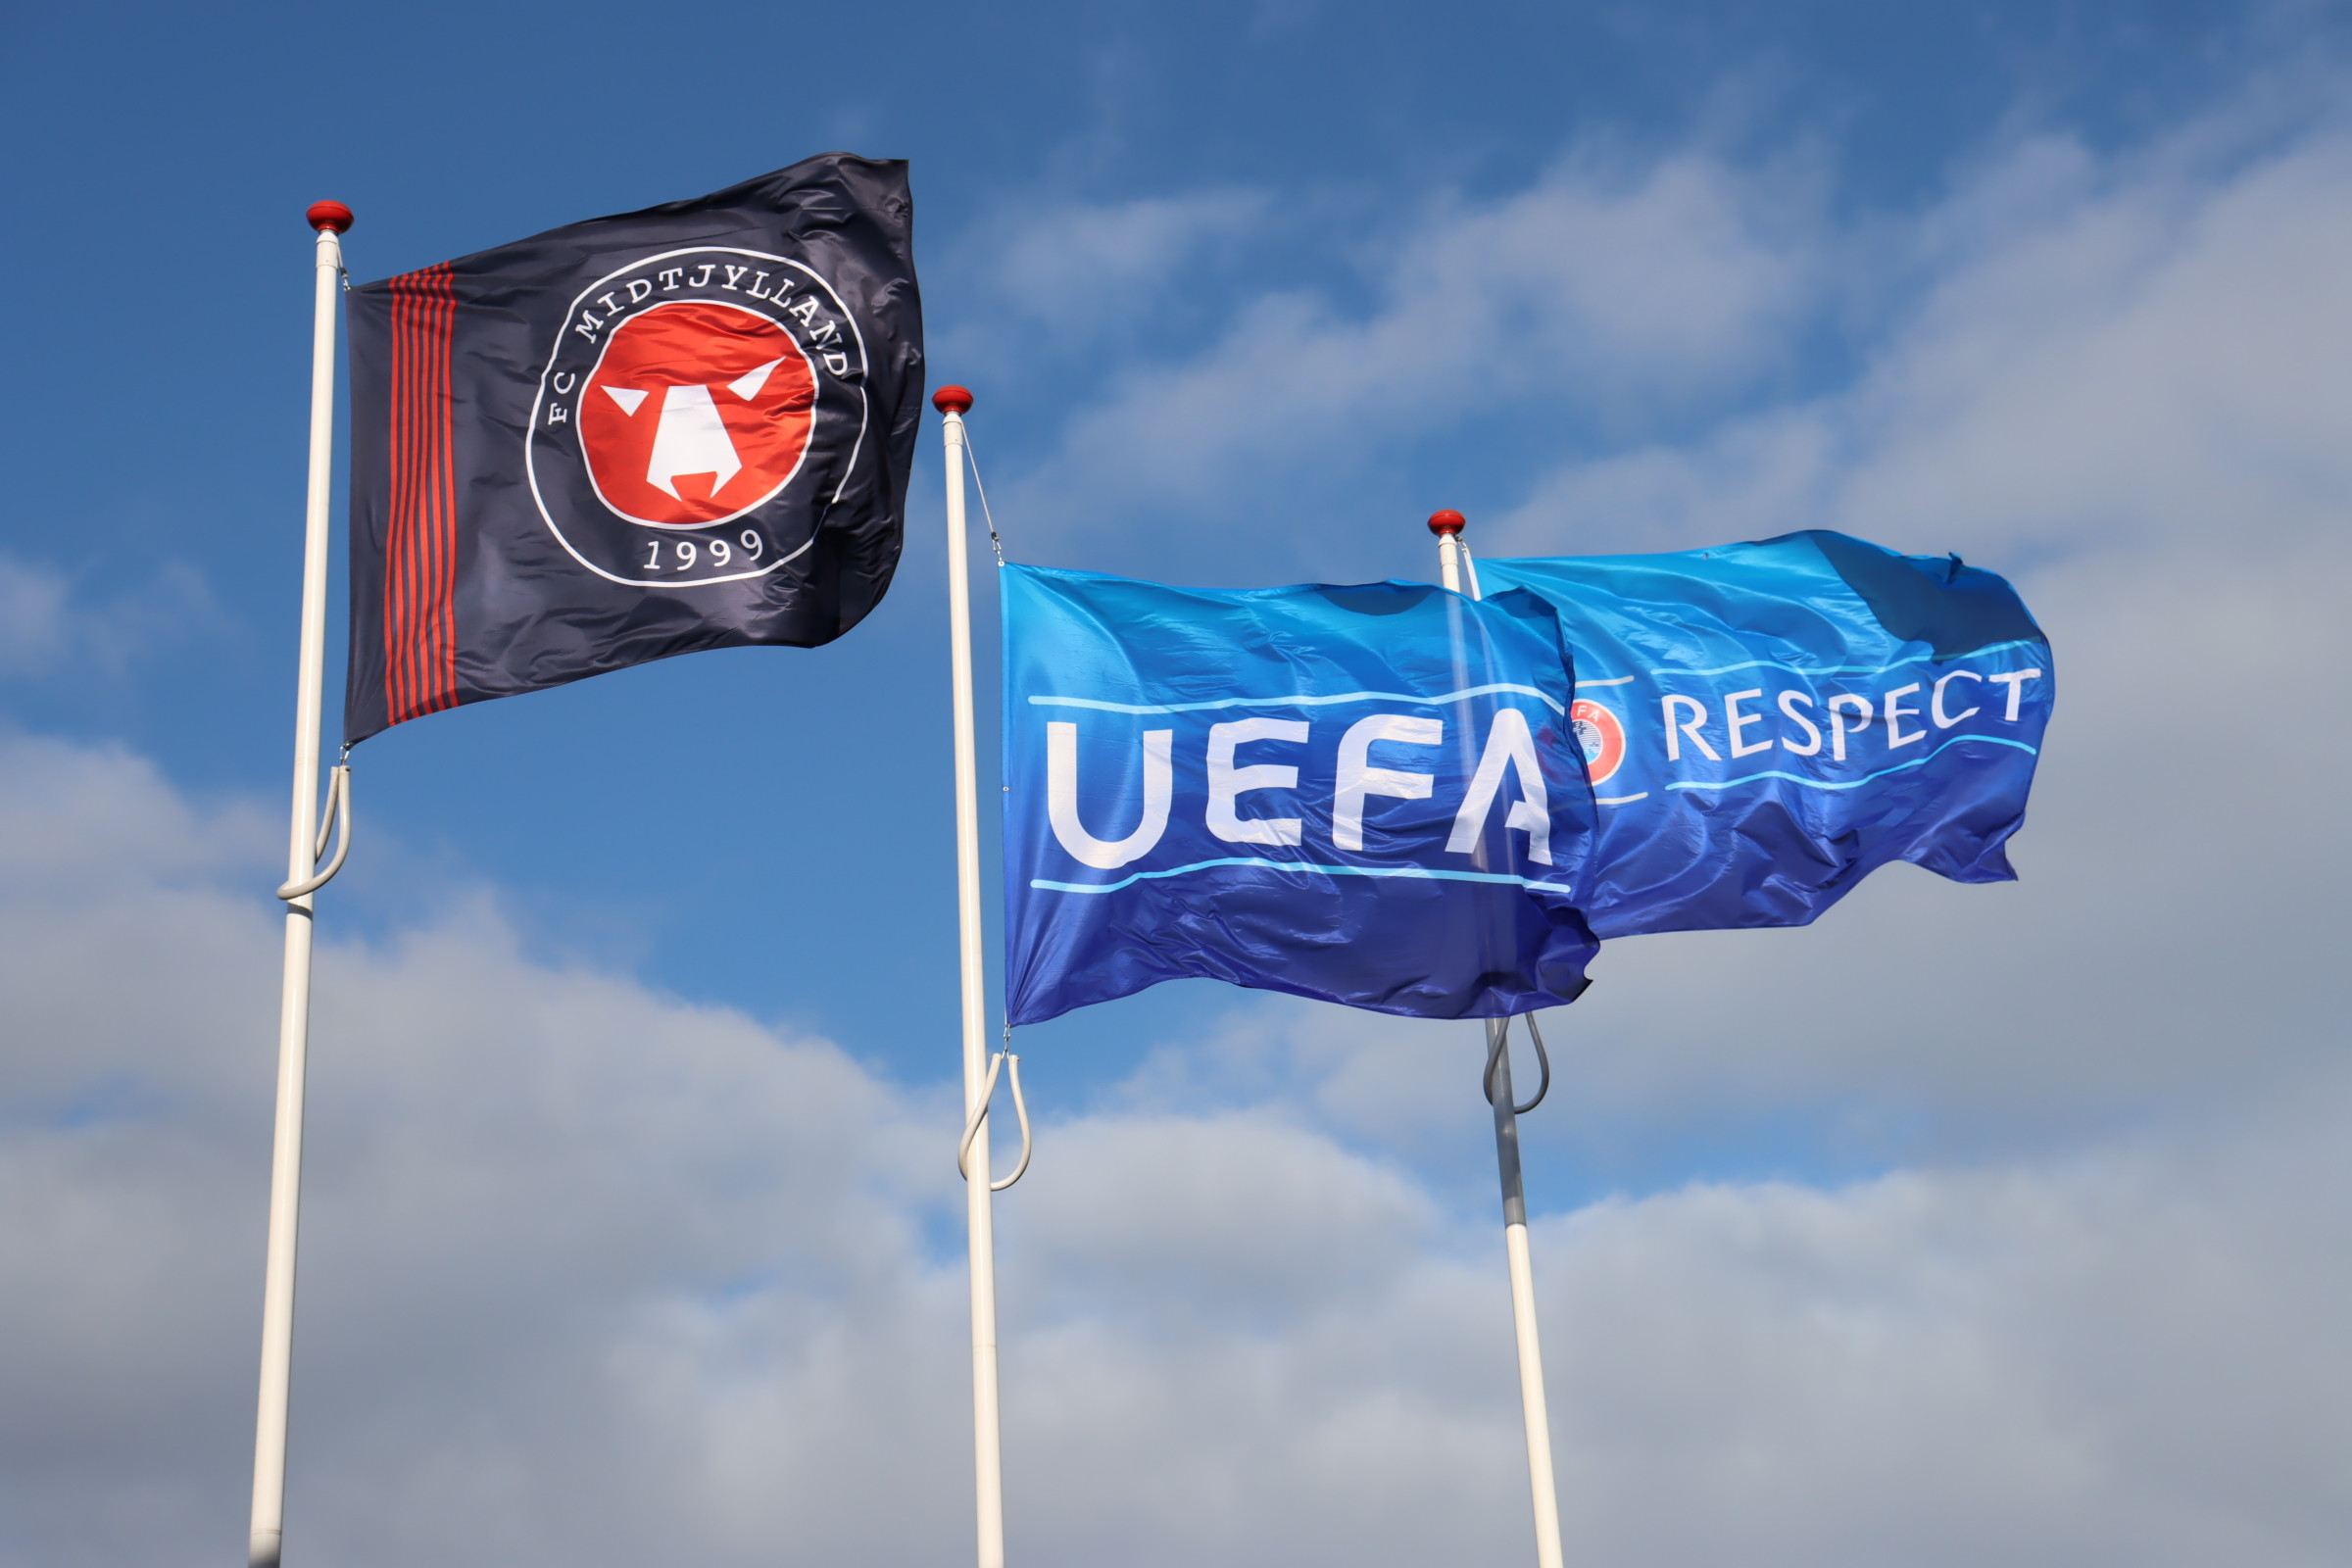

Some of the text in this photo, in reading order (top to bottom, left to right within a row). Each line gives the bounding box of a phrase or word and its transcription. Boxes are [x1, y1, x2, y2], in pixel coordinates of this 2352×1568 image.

[548, 265, 849, 425] FC MIDTJYLLAND
[643, 528, 763, 570] 1999
[1576, 705, 1600, 722] FA
[1660, 667, 2042, 762] RESPECT
[1047, 708, 1553, 870] UEFA
